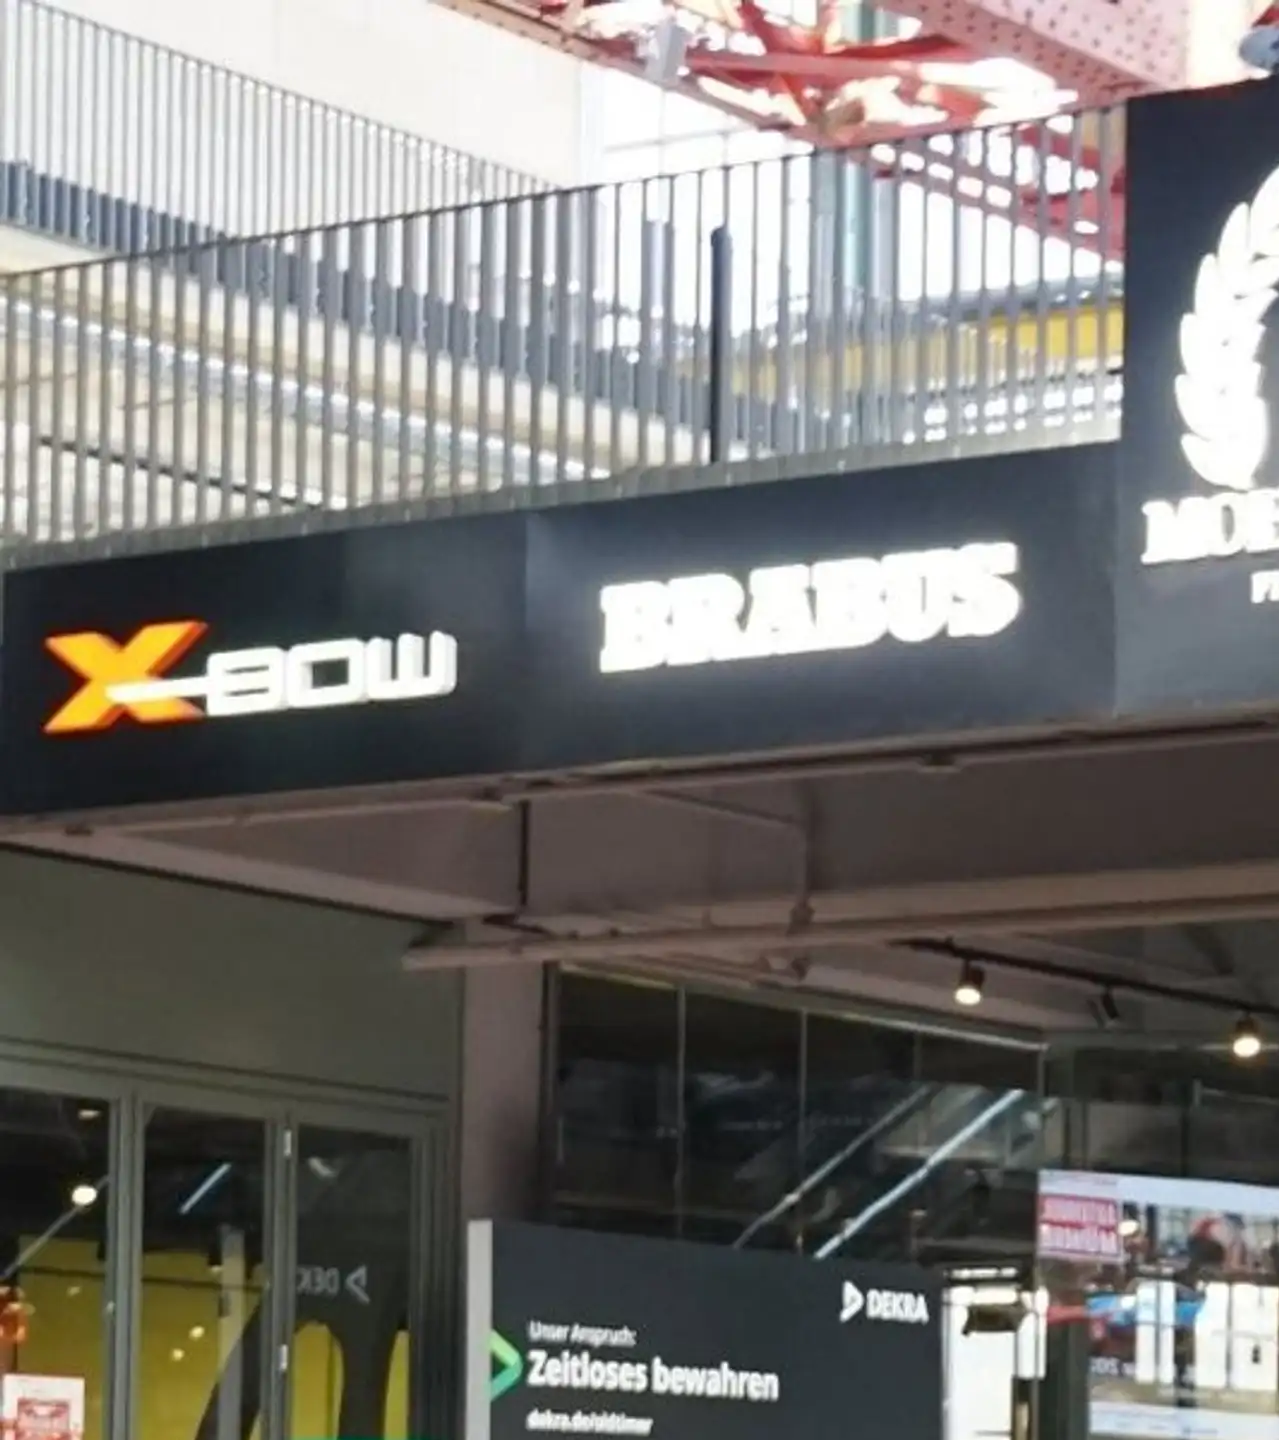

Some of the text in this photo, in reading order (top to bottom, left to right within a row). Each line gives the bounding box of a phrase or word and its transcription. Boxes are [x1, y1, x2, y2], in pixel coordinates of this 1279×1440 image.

[600, 541, 1020, 673] BRABUS
[866, 1288, 930, 1325] DEKRA
[527, 1350, 780, 1401] Zeitloses bewahren
